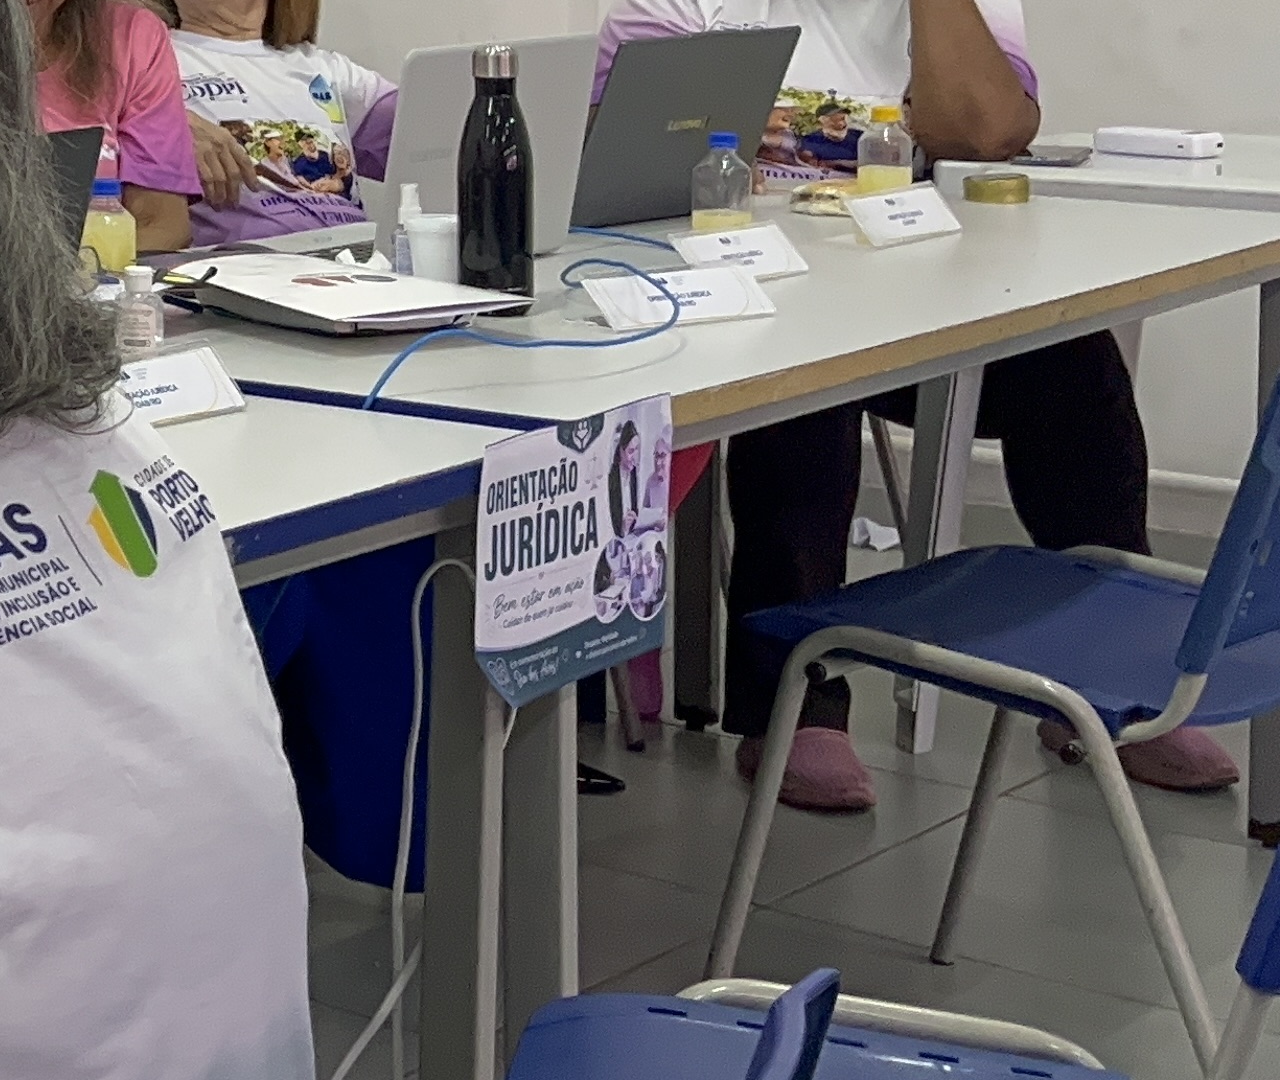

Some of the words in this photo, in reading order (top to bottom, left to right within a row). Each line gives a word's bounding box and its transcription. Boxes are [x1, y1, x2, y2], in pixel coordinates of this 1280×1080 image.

[148, 469, 198, 514] PORTO
[486, 457, 578, 515] ORIENTAÇÃO
[484, 497, 598, 581] JURÍDICA
[2, 581, 70, 618] INCLUSÃO
[70, 576, 81, 592] E
[45, 597, 98, 627] SOCIAL
